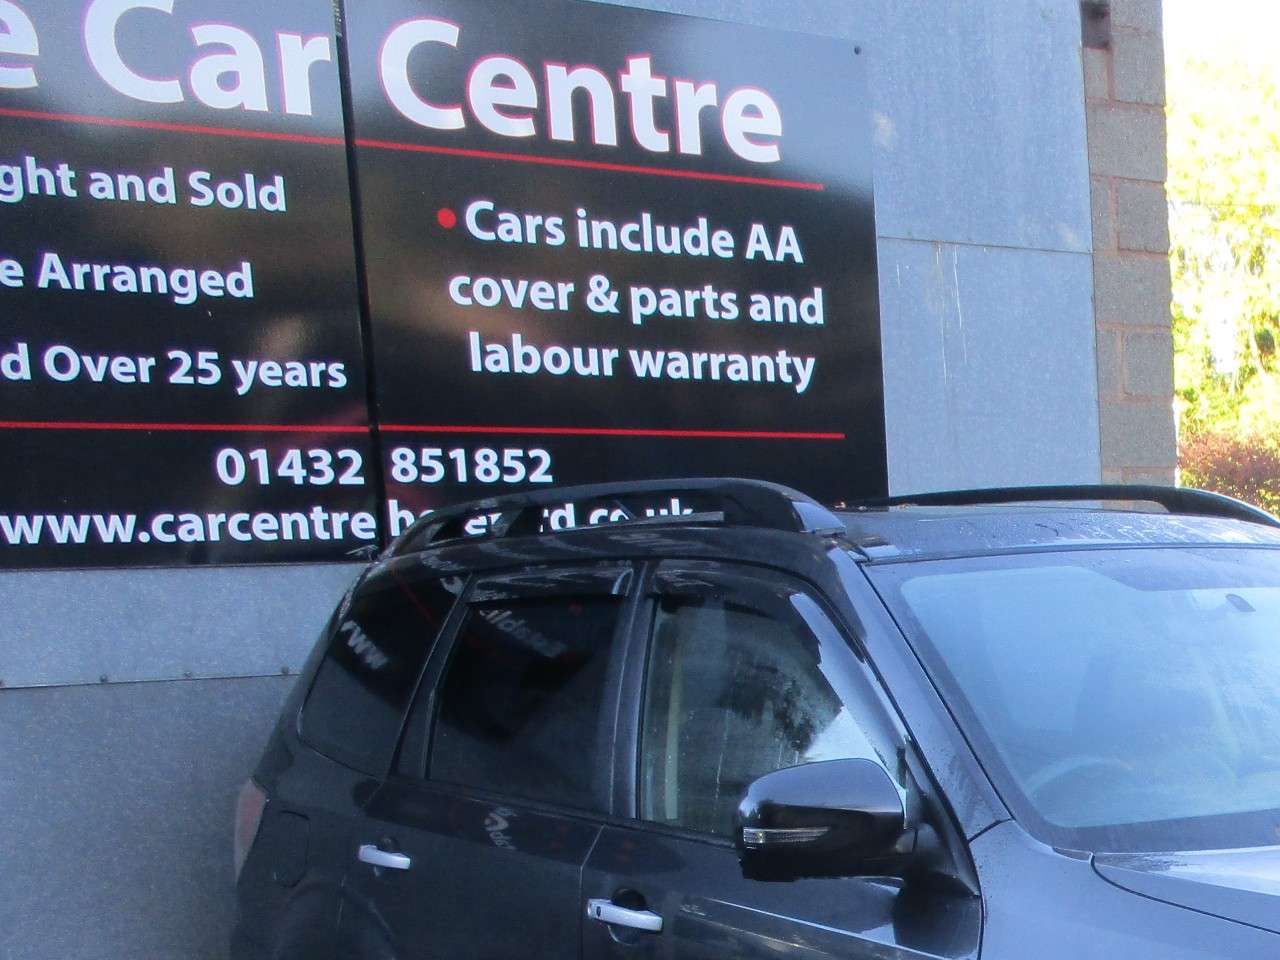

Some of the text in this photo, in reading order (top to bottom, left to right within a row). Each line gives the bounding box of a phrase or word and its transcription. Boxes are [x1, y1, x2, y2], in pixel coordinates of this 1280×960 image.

[84, 0, 331, 116] Car
[381, 19, 782, 162] Centre
[89, 167, 176, 204] and
[189, 171, 287, 211] Sold
[465, 200, 804, 264] Cars include AA
[38, 252, 254, 304] Arranged
[449, 274, 825, 325] cover & parts and
[44, 345, 155, 384] Over
[167, 350, 221, 385] 25
[232, 360, 348, 395] years
[469, 331, 815, 393] labour warranty
[216, 448, 553, 485] 01432 851852
